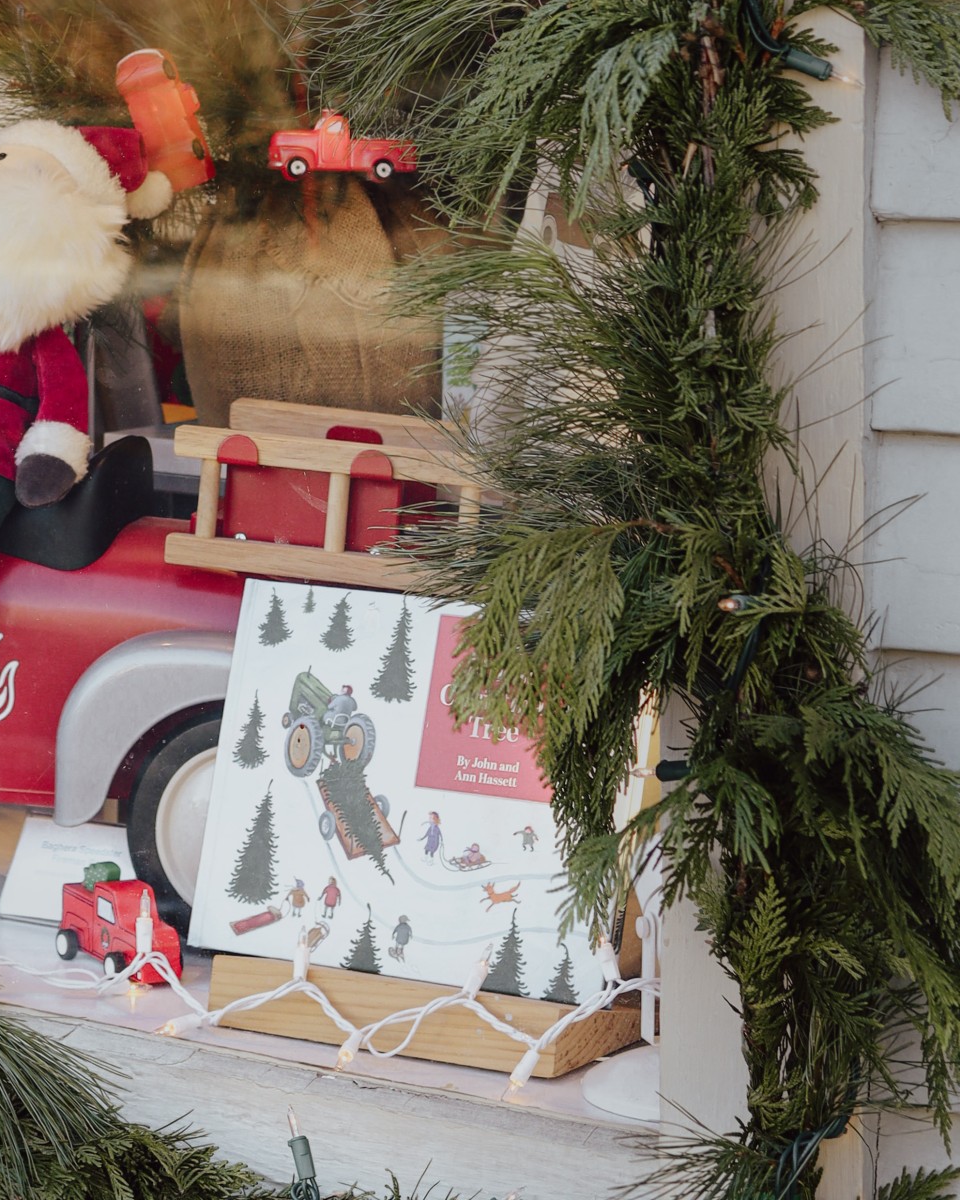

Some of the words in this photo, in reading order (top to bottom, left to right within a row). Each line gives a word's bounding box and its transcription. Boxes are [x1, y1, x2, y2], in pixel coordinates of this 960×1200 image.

[469, 715, 520, 743] Tree
[456, 755, 470, 770] By
[471, 757, 497, 771] John
[498, 761, 520, 773] and
[454, 770, 477, 783] Ann
[478, 772, 518, 788] Hassett
